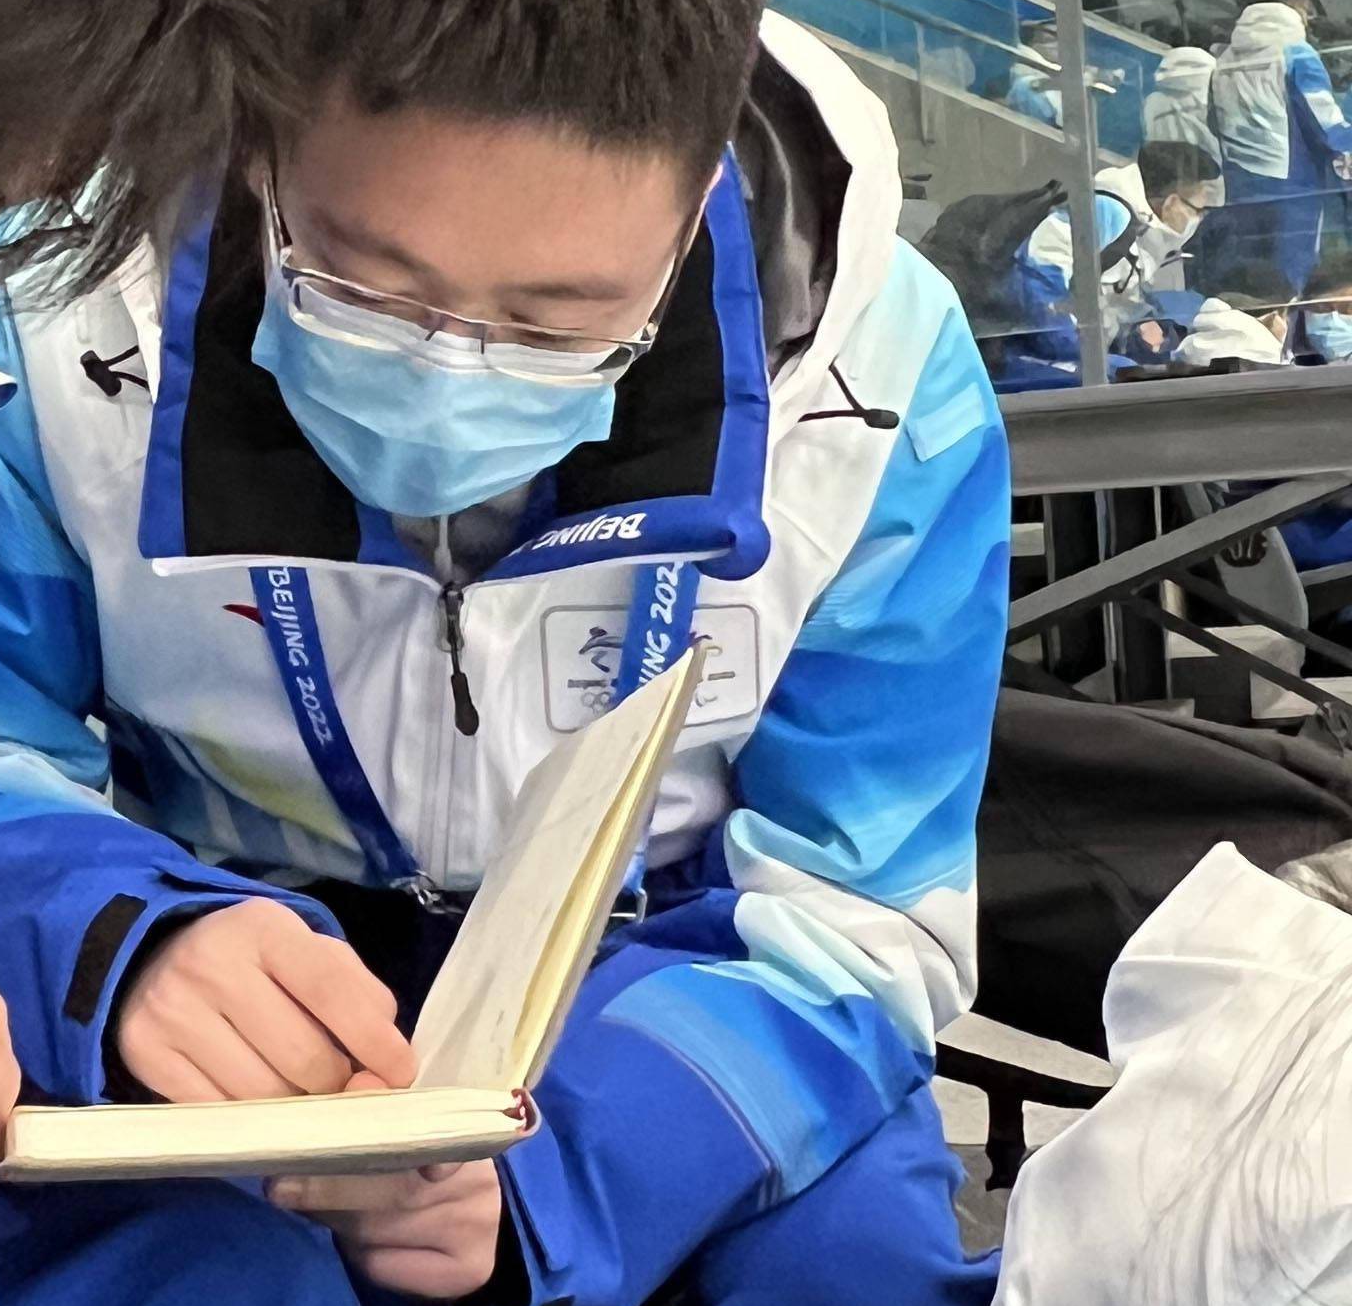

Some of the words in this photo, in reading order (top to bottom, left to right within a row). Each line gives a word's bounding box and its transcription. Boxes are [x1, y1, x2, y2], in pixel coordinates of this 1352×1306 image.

[650, 560, 684, 624] 202
[267, 566, 309, 667] BEIJING
[295, 675, 335, 749] 2022
